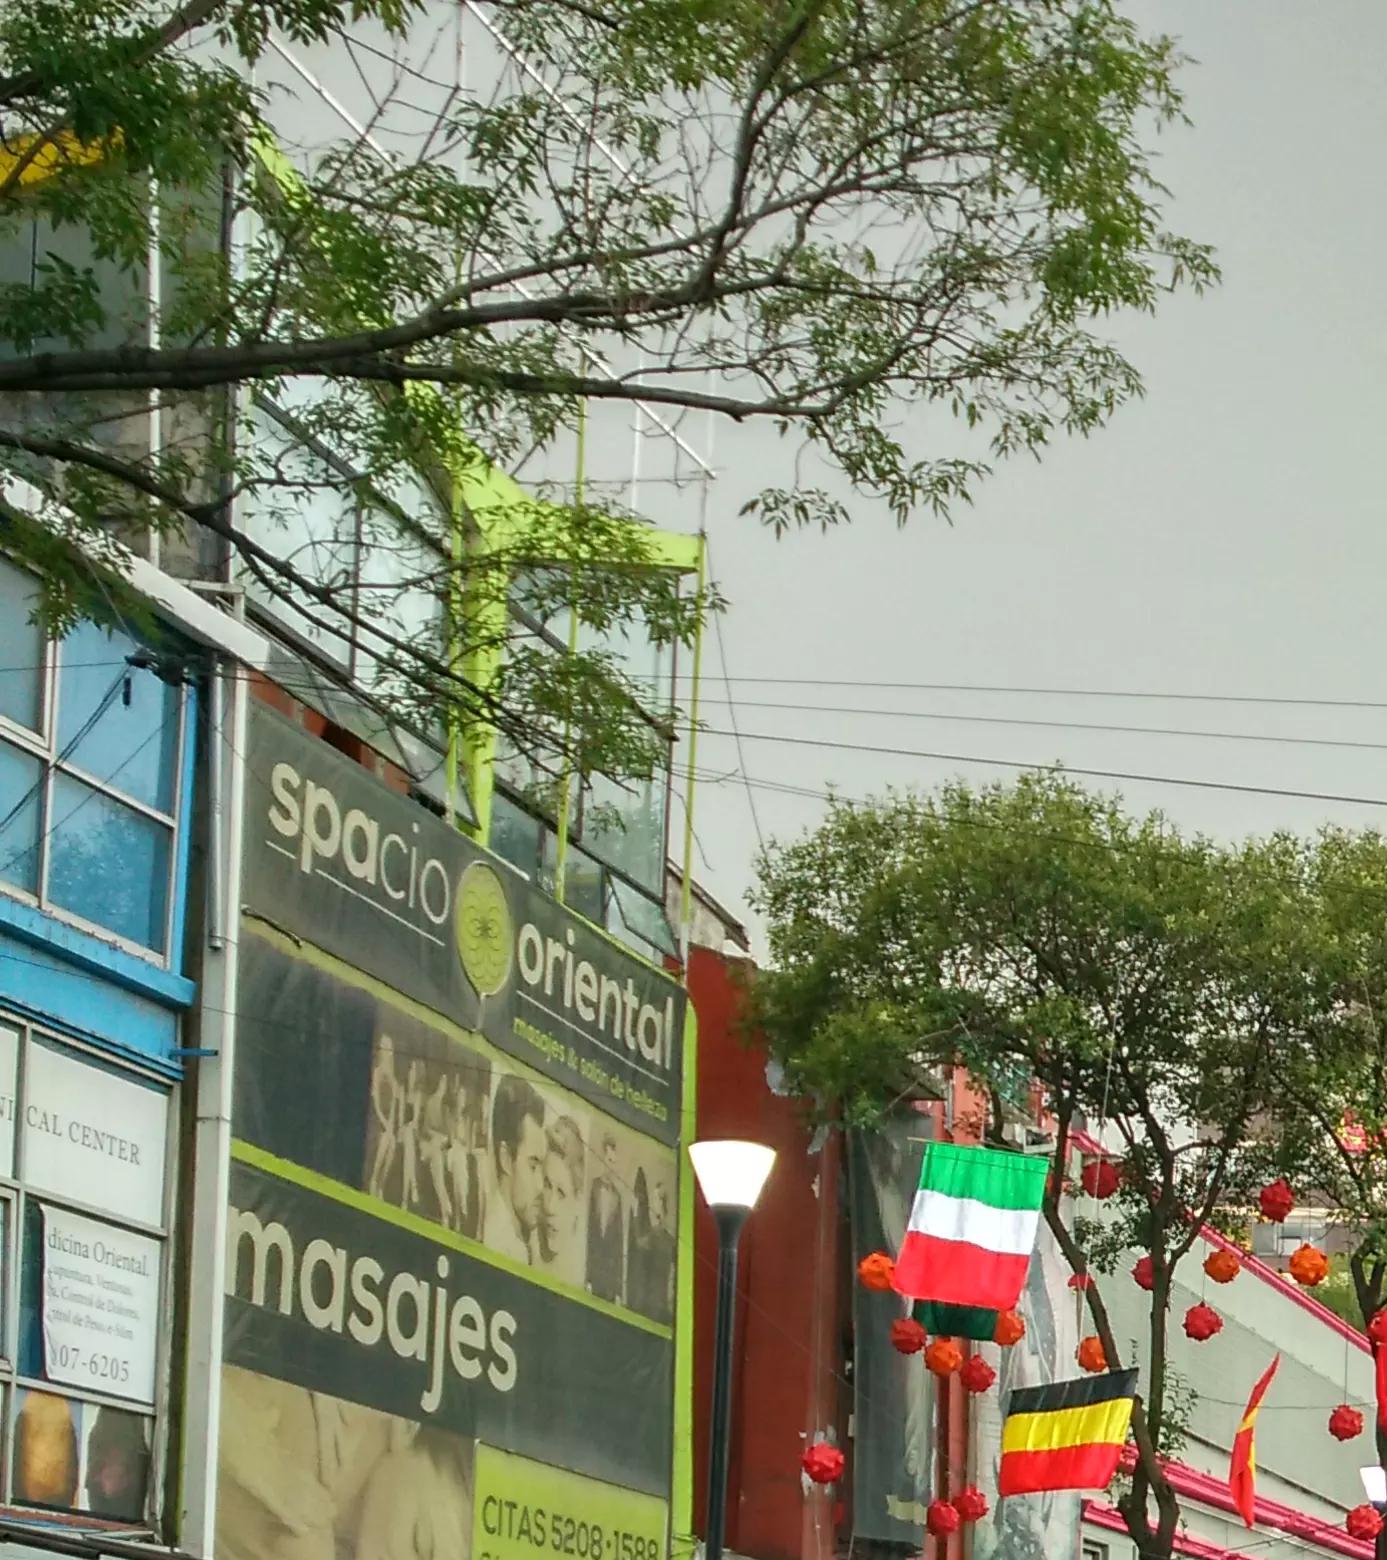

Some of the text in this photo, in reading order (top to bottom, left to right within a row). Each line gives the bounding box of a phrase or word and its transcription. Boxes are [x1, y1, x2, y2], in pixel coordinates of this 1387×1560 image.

[267, 762, 673, 1070] spacio oriental
[513, 1017, 565, 1063] masajes
[68, 1121, 140, 1165] CENTER
[224, 1204, 518, 1413] masajes
[482, 1495, 546, 1548] CITAS
